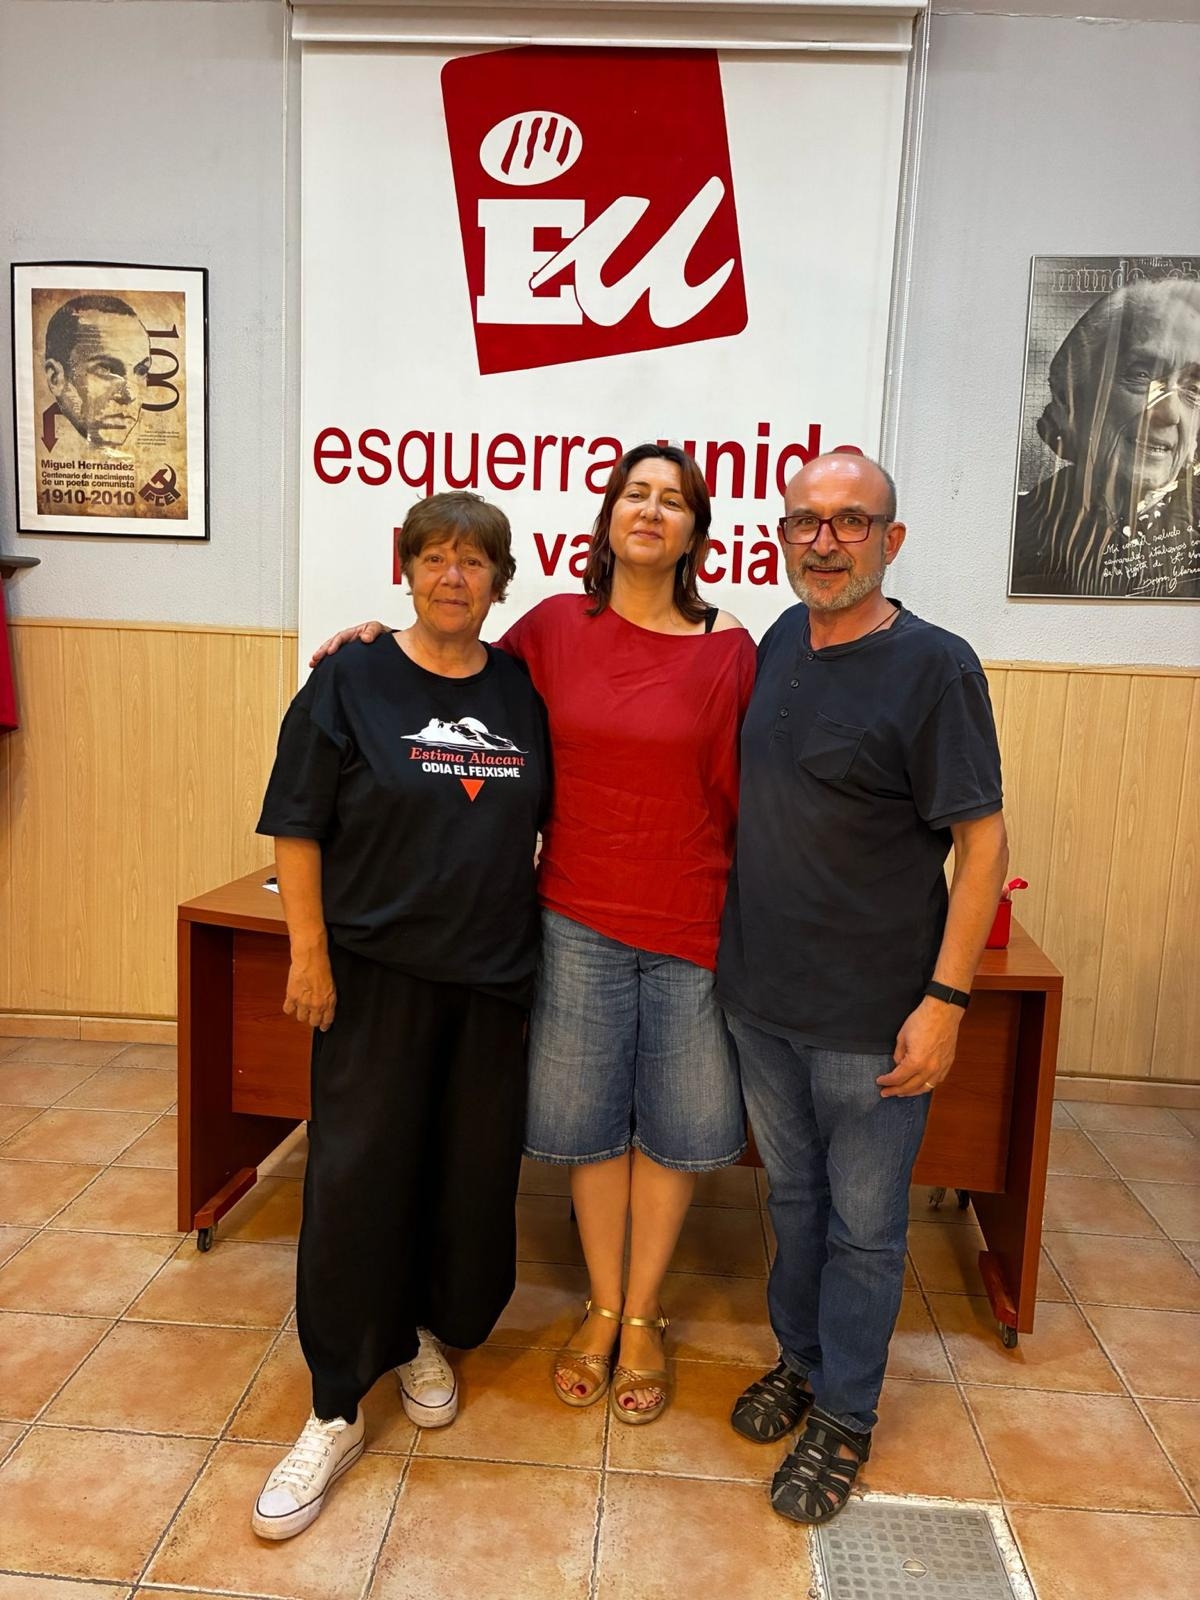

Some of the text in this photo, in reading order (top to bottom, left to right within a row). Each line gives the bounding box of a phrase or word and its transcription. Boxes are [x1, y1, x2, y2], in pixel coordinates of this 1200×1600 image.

[41, 460, 135, 471] Miguel Hernández
[313, 425, 623, 495] esquerra
[656, 421, 864, 500] nid
[41, 471, 135, 481] Centenario del nacimiento
[41, 478, 51, 486] de
[66, 479, 90, 488] poeta
[92, 480, 135, 489] comunista
[42, 488, 135, 506] 1910-2010
[142, 491, 178, 507] PCE
[408, 747, 526, 767] Estima Alacant
[421, 761, 521, 778] ODIA EL FEIXISME
